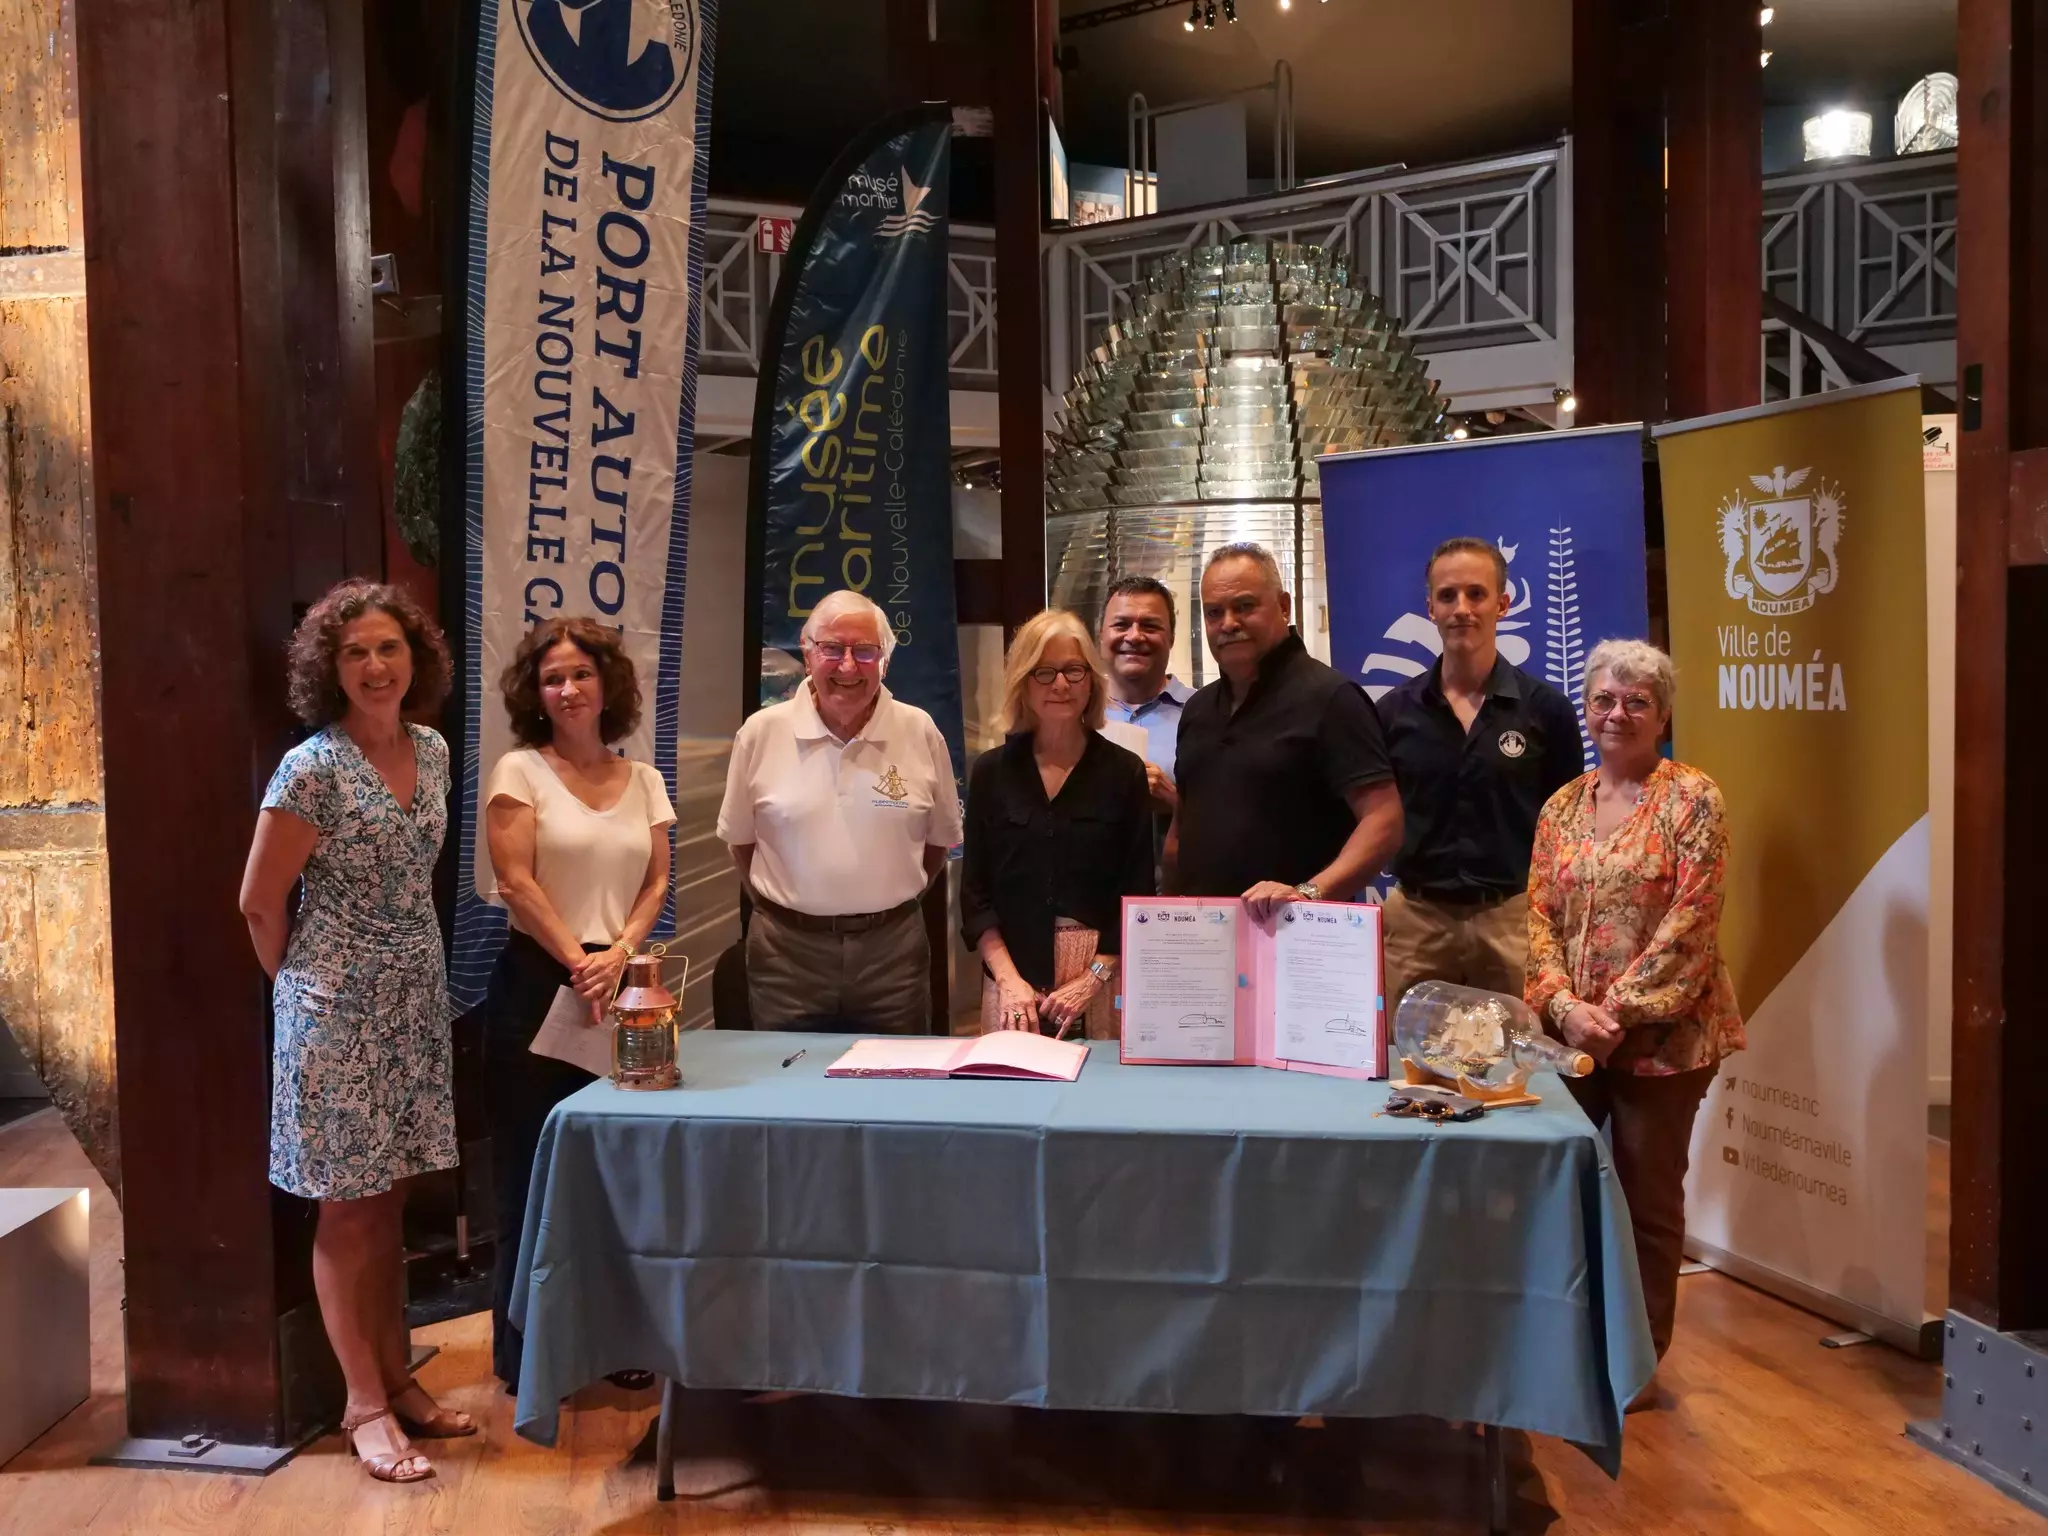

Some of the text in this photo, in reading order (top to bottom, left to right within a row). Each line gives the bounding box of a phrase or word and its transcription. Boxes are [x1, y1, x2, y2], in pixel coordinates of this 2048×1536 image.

[670, 0, 688, 53] EDONIE
[543, 129, 580, 203] DE
[540, 209, 577, 277] LA
[589, 150, 656, 634] PORT AUTO
[526, 288, 575, 564] NOUVELLE
[783, 334, 848, 618] musée
[839, 324, 889, 600] aritime
[884, 329, 913, 647] de Nouvelle-Calédonie
[1751, 598, 1811, 614] NOUMEA
[1717, 623, 1791, 657] Ville de
[1718, 648, 1847, 711] NOUMÉA
[1742, 1079, 1820, 1117] noumea.nc
[1741, 1112, 1852, 1168] Nouméamaville
[1743, 1151, 1847, 1206] Villedenoumea
